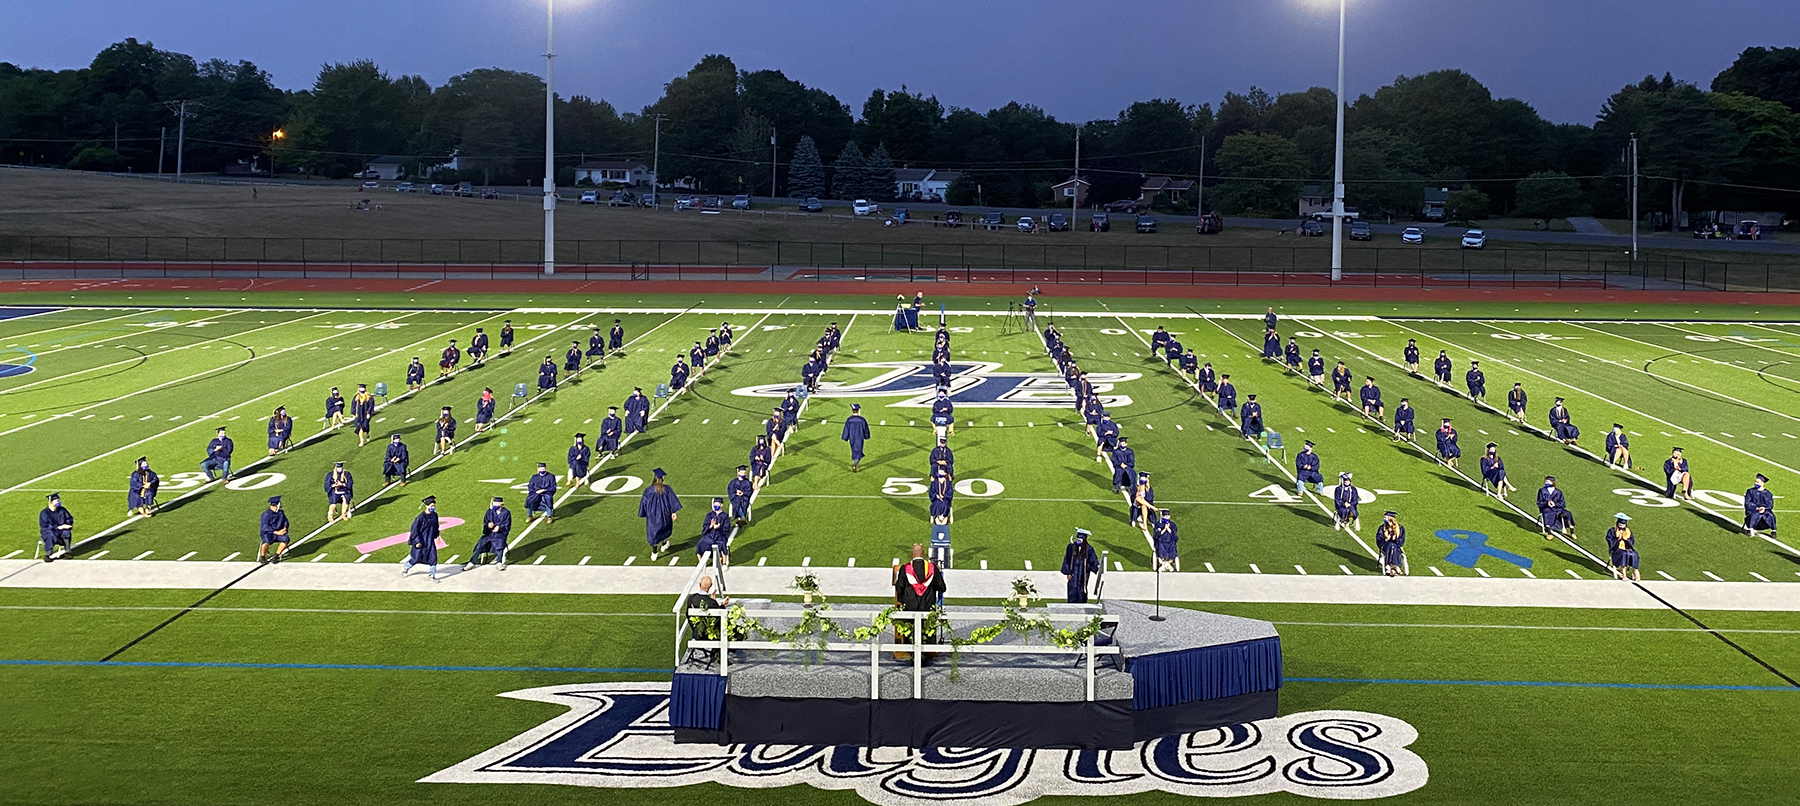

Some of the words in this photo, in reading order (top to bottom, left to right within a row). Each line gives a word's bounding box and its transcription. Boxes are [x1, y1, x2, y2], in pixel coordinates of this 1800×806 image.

[158, 472, 286, 491] 30
[881, 477, 1004, 496] 50
[1612, 488, 1746, 509] 30
